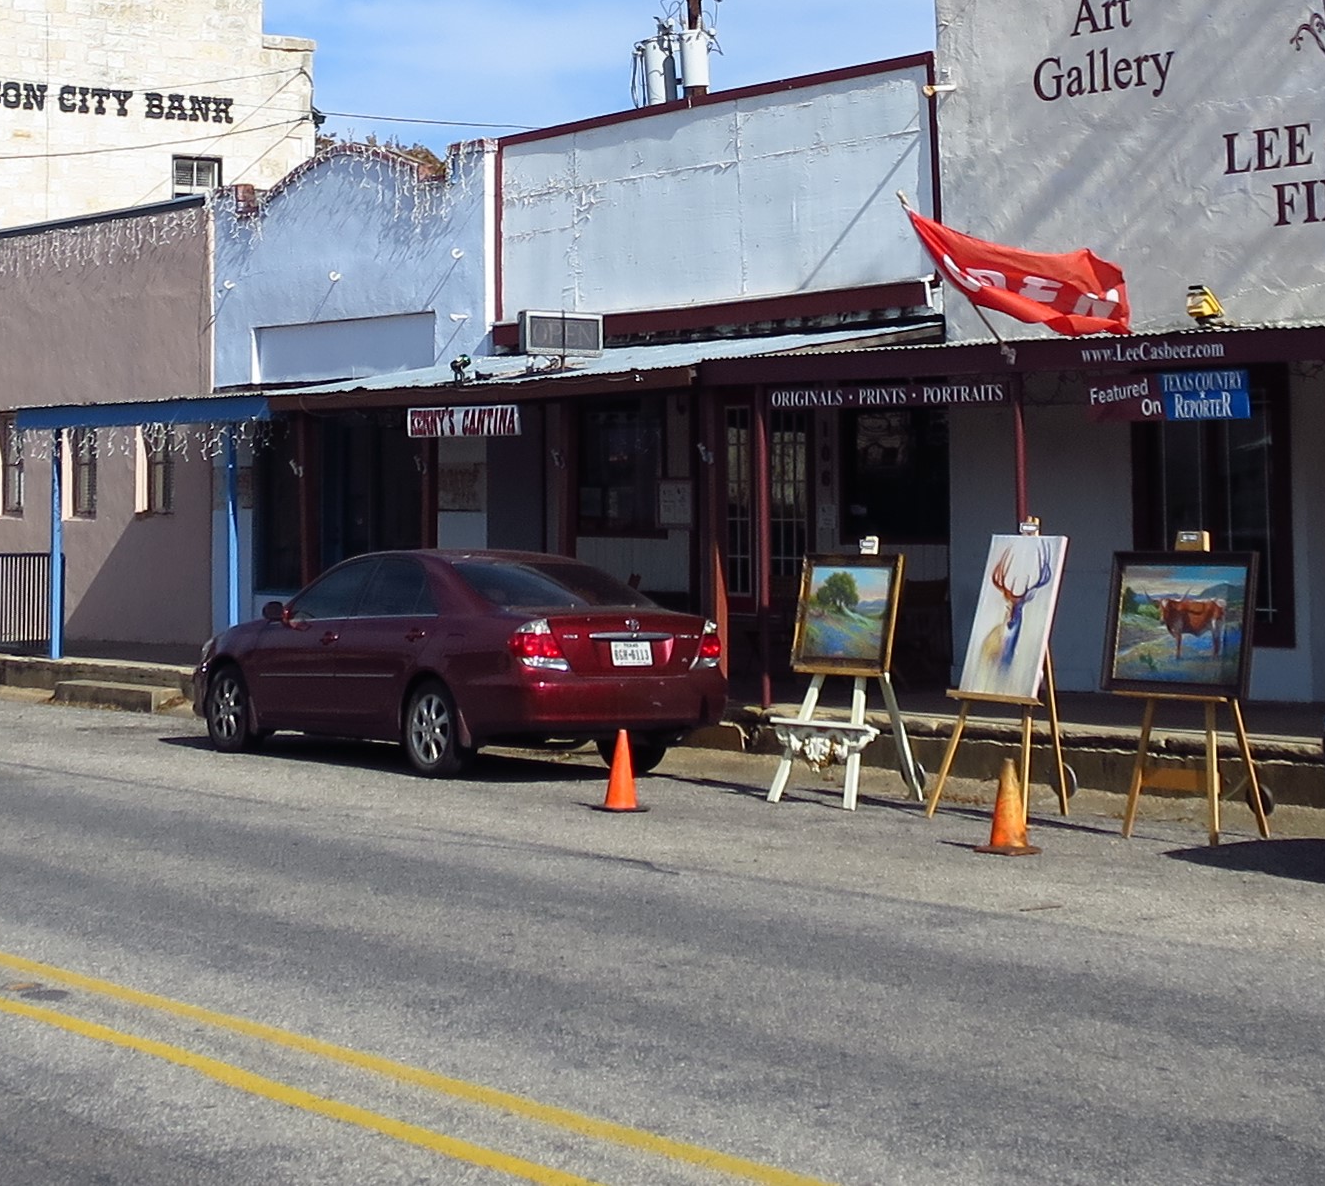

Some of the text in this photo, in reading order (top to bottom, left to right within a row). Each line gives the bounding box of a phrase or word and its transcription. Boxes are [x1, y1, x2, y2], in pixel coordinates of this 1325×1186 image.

[1033, 47, 1175, 101] Gallery
[58, 85, 133, 116] CITY
[144, 92, 234, 123] BANK
[1222, 123, 1313, 174] LEE
[532, 321, 597, 347] OPEN
[1081, 341, 1225, 363] www.LeeCasbeer.com
[1090, 378, 1149, 405] Featured
[1163, 371, 1242, 392] TEXAS COUNTRY
[772, 384, 1004, 407] ORIGINALS PRINTS PORTRAITS
[1141, 398, 1162, 416] On
[1174, 391, 1233, 419] REPORTER
[461, 406, 516, 436] CANTINA
